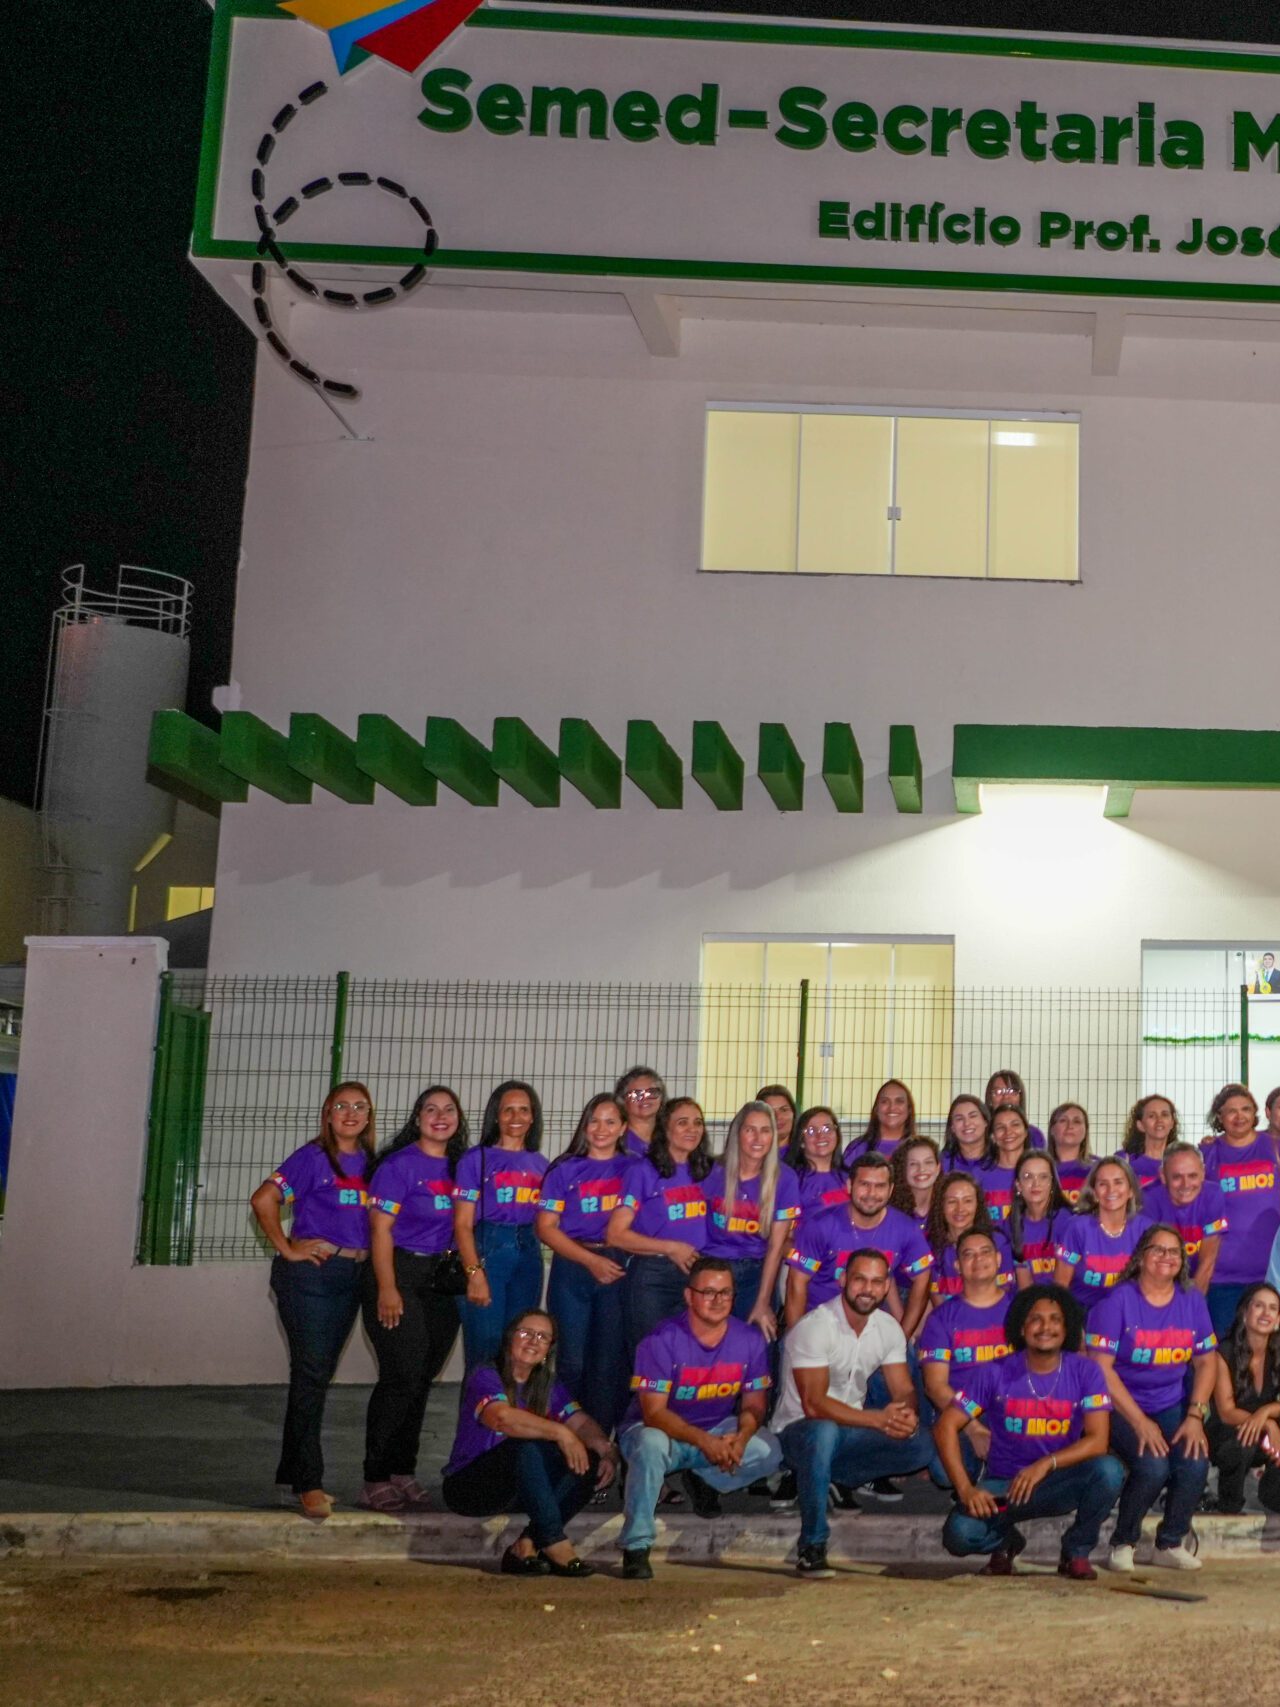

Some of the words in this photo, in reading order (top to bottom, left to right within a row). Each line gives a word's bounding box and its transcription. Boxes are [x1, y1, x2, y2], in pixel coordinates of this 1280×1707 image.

[818, 200, 1022, 246] Edifício
[1039, 210, 1161, 252] Prof.
[1220, 1177, 1236, 1193] 62
[1239, 1173, 1275, 1191] ANOS
[339, 1188, 359, 1205] 62
[434, 1194, 452, 1210] 62
[496, 1186, 514, 1204] 62
[581, 1196, 599, 1214] 62
[667, 1202, 684, 1221] 62
[1084, 1270, 1101, 1288] 62
[955, 1347, 973, 1363] 62
[1131, 1346, 1151, 1365] 62
[1153, 1346, 1192, 1366] ANOS
[675, 1385, 696, 1401] 62
[697, 1381, 740, 1401] ANOS
[1004, 1416, 1022, 1434] 62
[1026, 1417, 1070, 1436] ANOS
